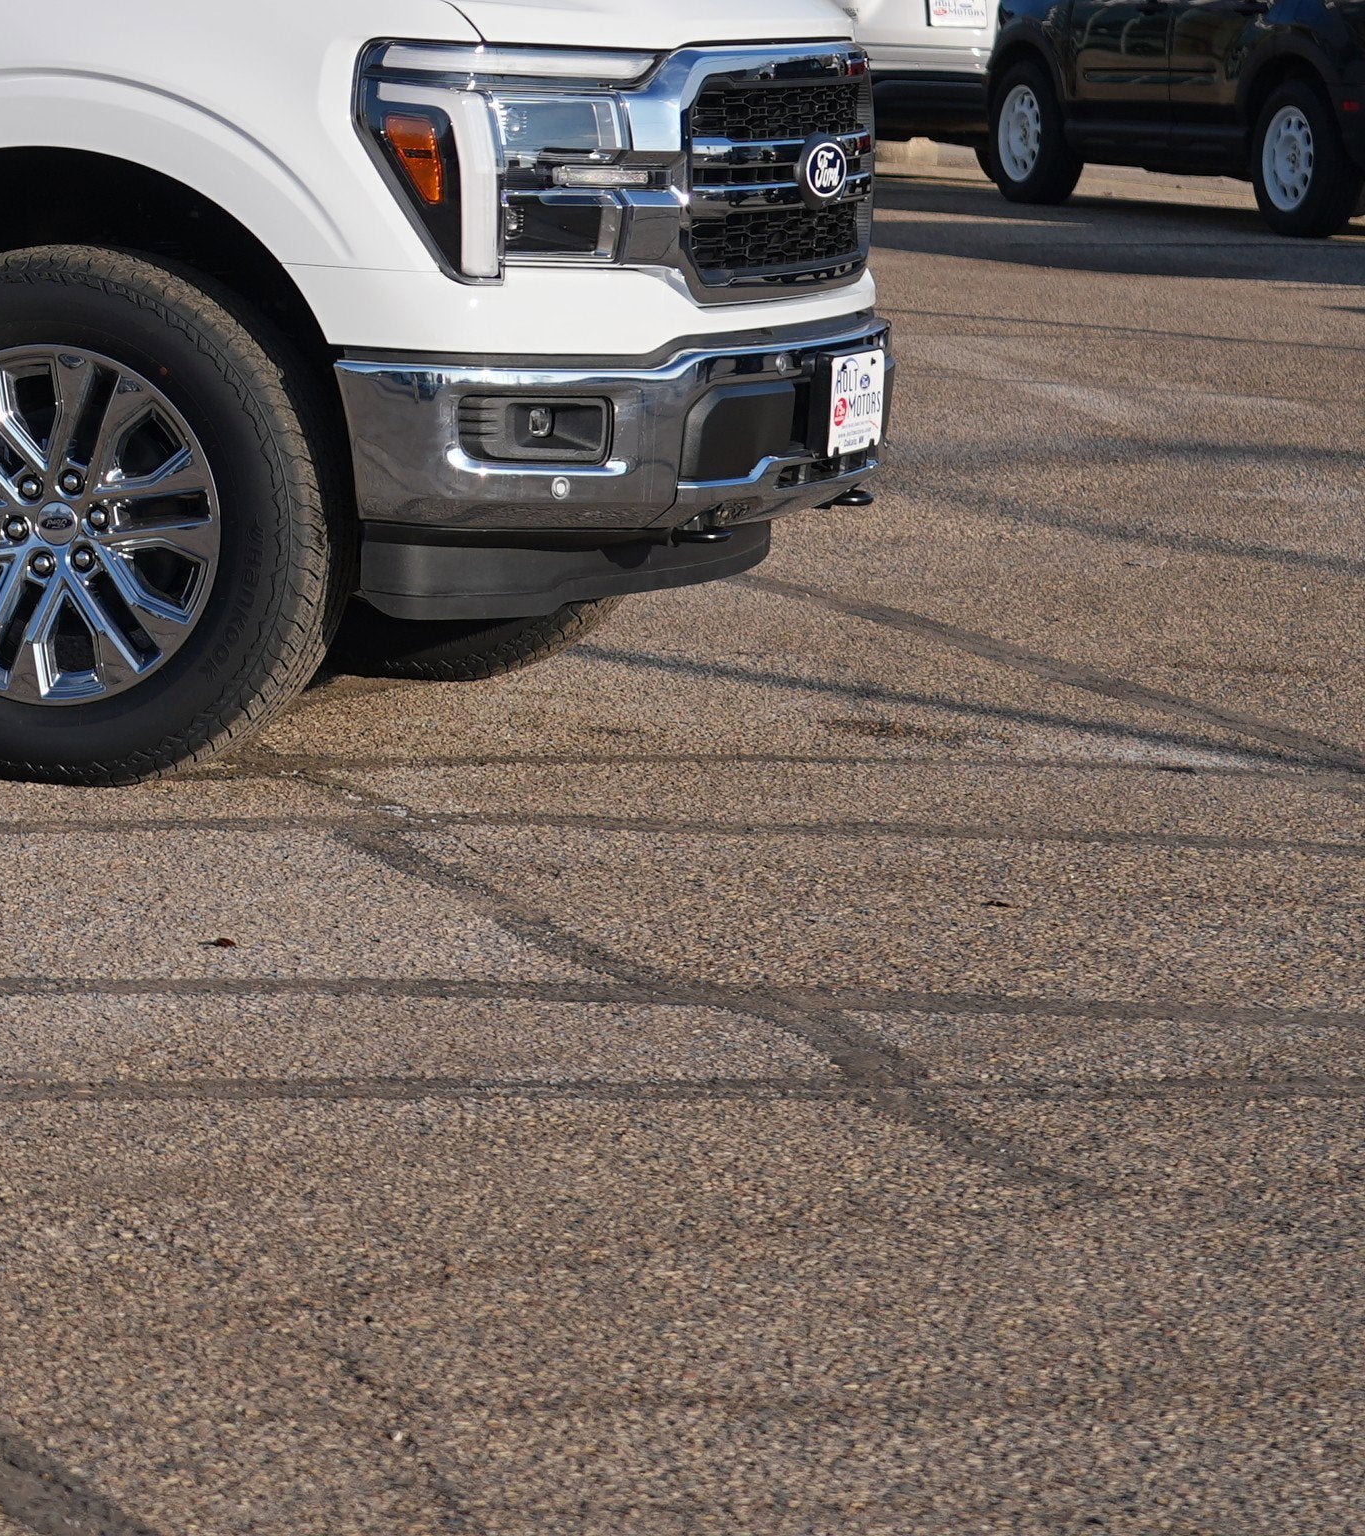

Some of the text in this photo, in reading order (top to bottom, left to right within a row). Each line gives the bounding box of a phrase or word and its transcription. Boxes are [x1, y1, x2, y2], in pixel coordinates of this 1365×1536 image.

[814, 150, 841, 188] Ford
[836, 368, 859, 394] HOLT
[848, 390, 881, 418] MOTORS
